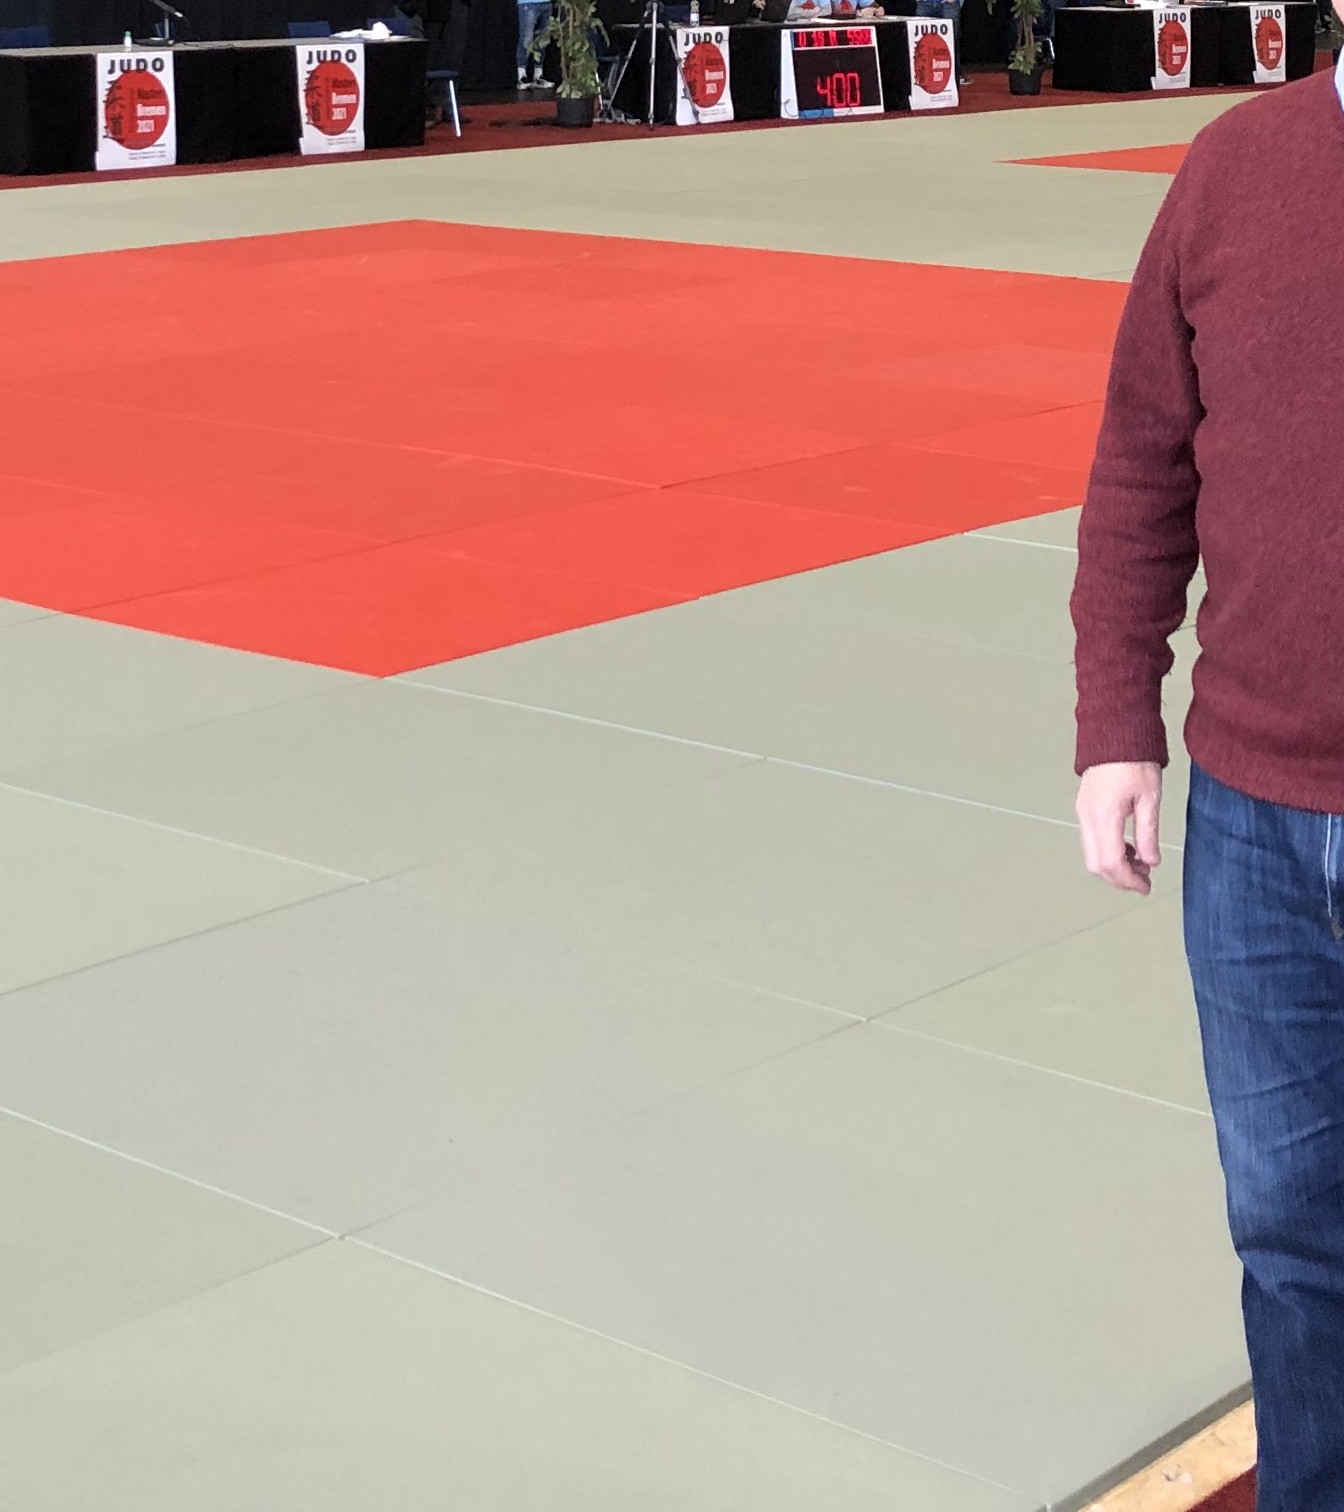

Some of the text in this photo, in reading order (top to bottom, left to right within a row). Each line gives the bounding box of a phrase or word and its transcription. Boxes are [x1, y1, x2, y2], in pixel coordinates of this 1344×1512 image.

[1158, 12, 1187, 24] JUDO
[1255, 9, 1281, 20] JUDO
[914, 24, 949, 37] JUDO
[684, 31, 724, 46] JUDO
[306, 49, 357, 65] JUDO
[107, 57, 165, 75] JUDO
